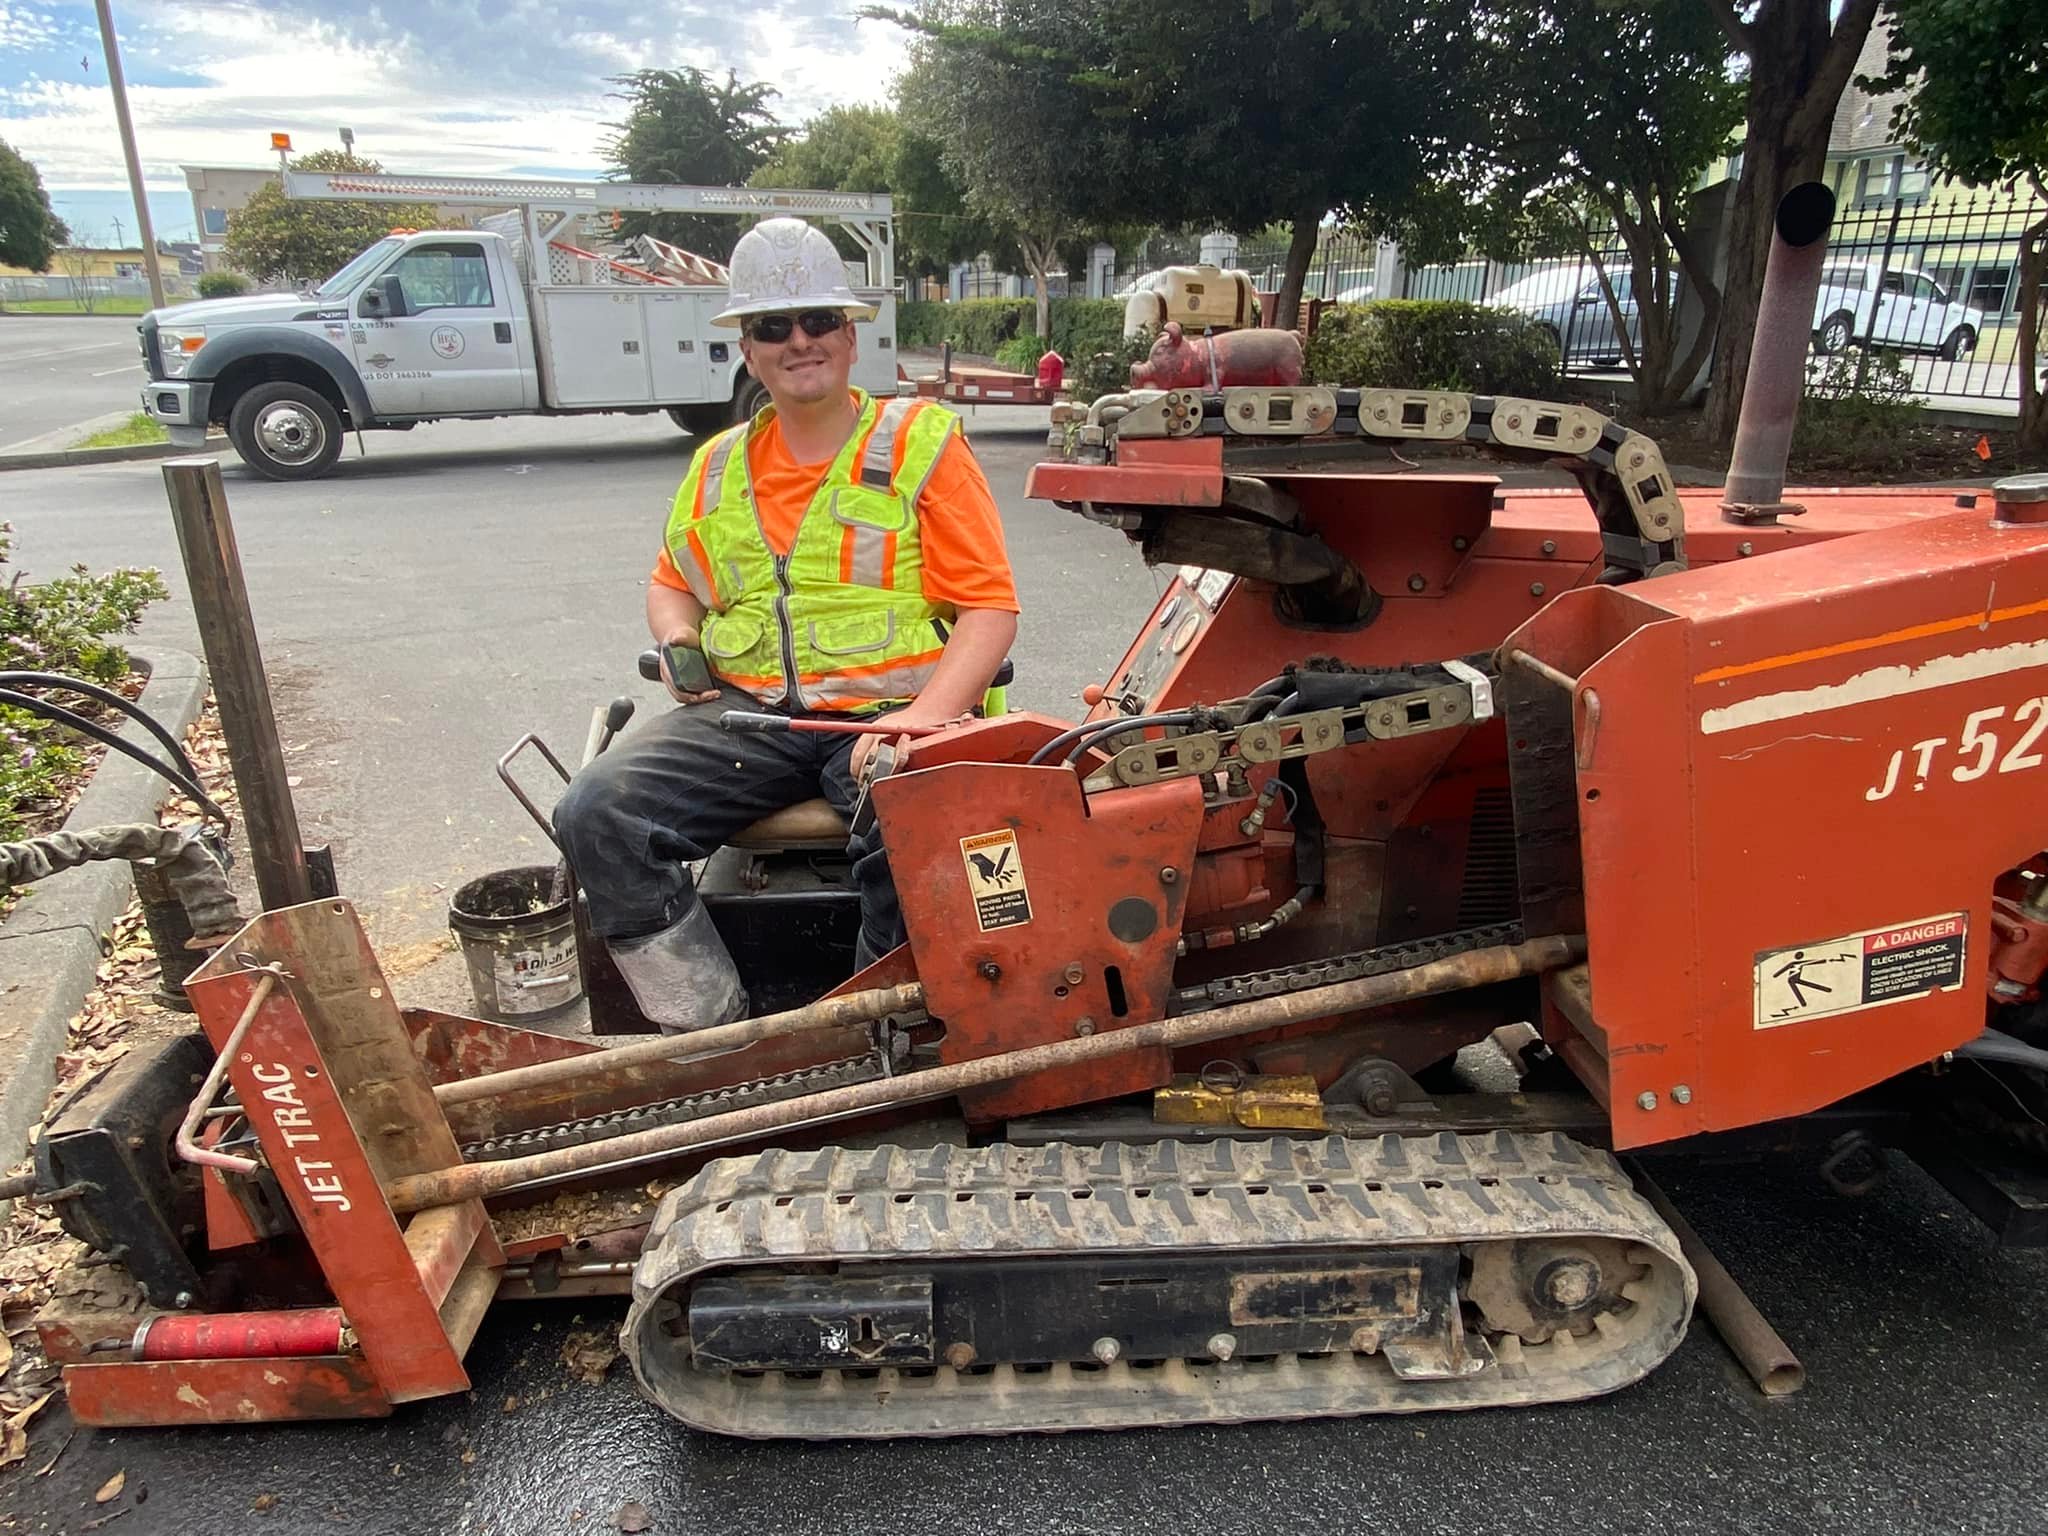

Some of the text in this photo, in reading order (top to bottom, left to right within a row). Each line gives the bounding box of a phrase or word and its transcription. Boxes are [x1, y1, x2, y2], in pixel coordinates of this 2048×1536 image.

[351, 322, 363, 330] CA
[376, 372, 393, 380] DOT
[1890, 921, 1956, 945] DANGER
[1871, 950, 1915, 966] ELECTRIC
[1890, 973, 1923, 985] LOCATION
[294, 1155, 352, 1212] JET
